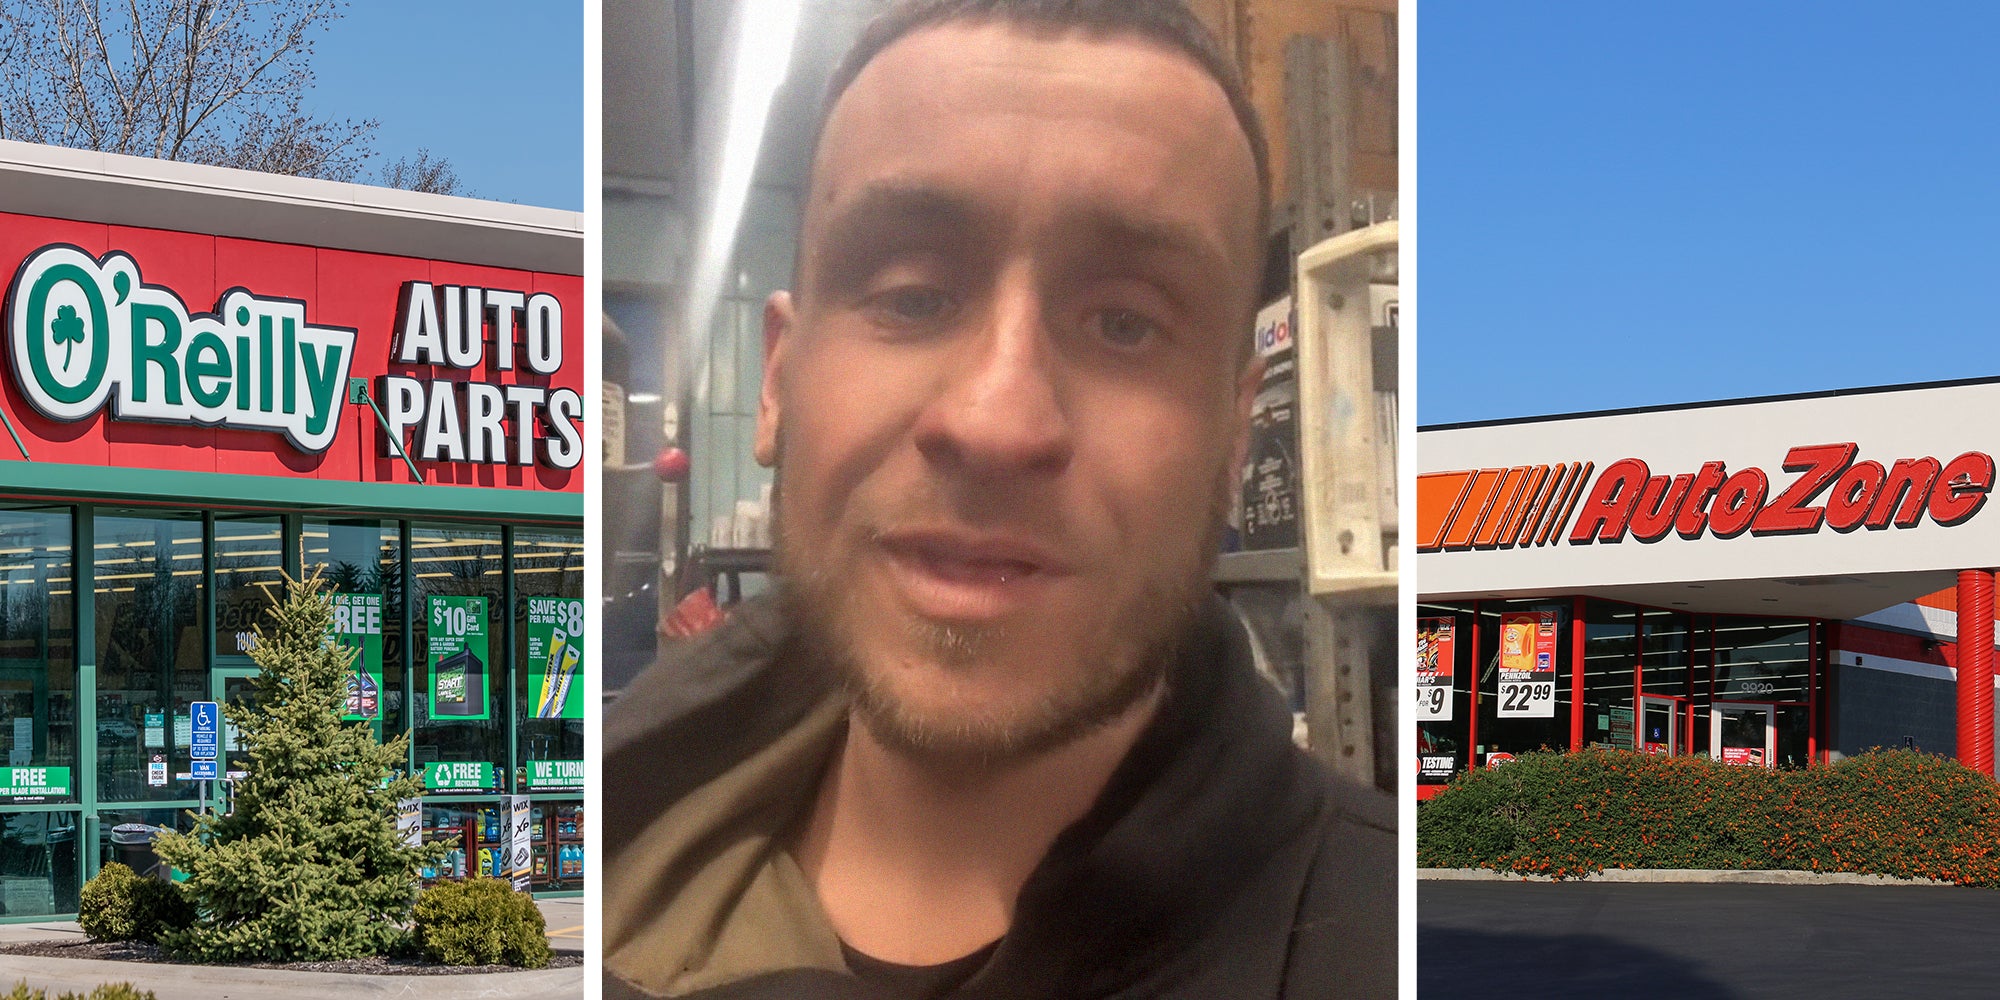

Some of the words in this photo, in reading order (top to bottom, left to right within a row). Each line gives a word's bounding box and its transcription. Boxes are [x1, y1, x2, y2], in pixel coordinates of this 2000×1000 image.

[400, 281, 564, 376] AUTO
[24, 260, 345, 438] O'Reilly
[384, 376, 583, 470] PARTS
[1568, 442, 1995, 547] AutoZone
[353, 596, 365, 605] GET
[367, 597, 380, 606] ONE
[322, 606, 380, 634] REE
[434, 606, 466, 636] $10
[530, 599, 556, 615] SAVE
[557, 600, 583, 637] $8
[530, 616, 541, 624] PER
[542, 616, 556, 624] PAIR
[1500, 672, 1532, 680] PENNZOIL
[1741, 682, 1774, 694] 9920
[453, 763, 481, 779] FREE
[535, 762, 553, 778] WE
[555, 762, 584, 778] TURN
[1422, 756, 1454, 770] TESTING
[12, 768, 47, 786] FREE
[11, 787, 29, 795] BLADE
[30, 787, 66, 795] INSTALLATION
[513, 800, 529, 813] WIX
